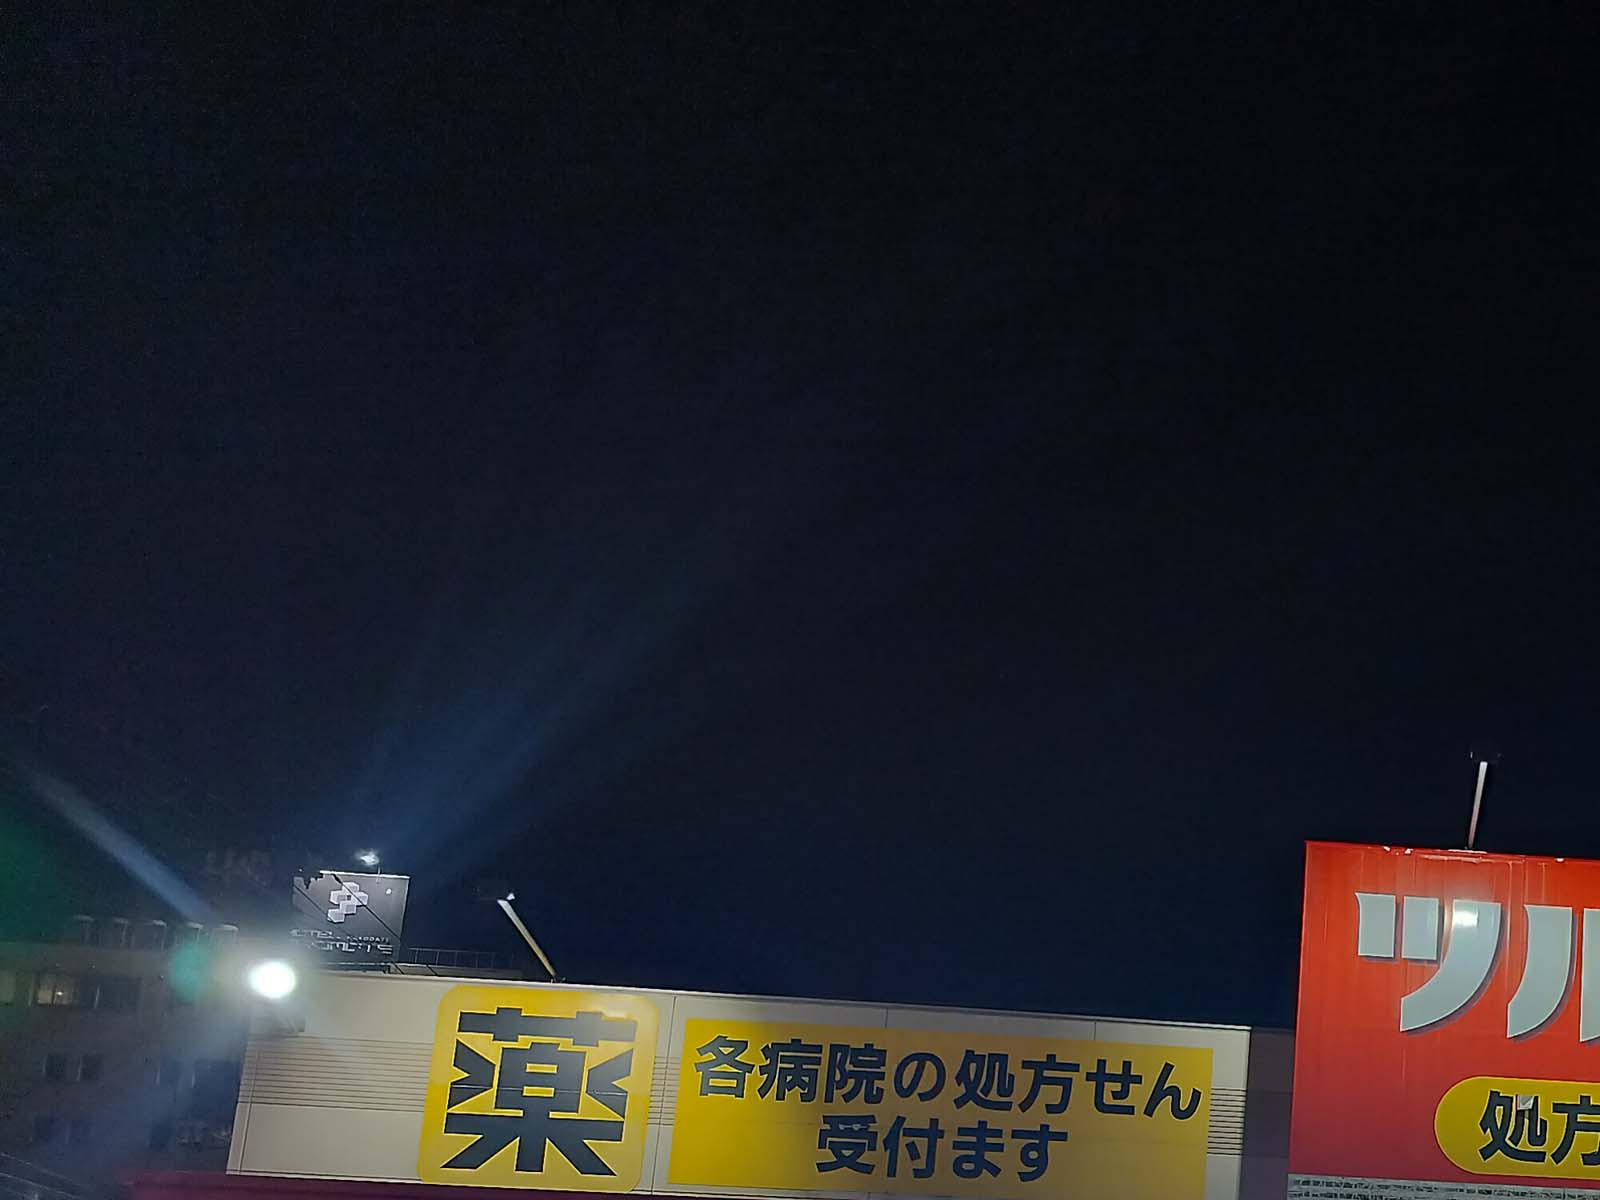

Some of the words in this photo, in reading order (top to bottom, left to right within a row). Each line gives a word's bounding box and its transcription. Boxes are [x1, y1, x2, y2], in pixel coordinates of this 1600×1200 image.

[440, 1007, 638, 1177] 薬
[694, 1035, 1202, 1121] 各病院の処方せん
[815, 1113, 1069, 1182] 受付ます
